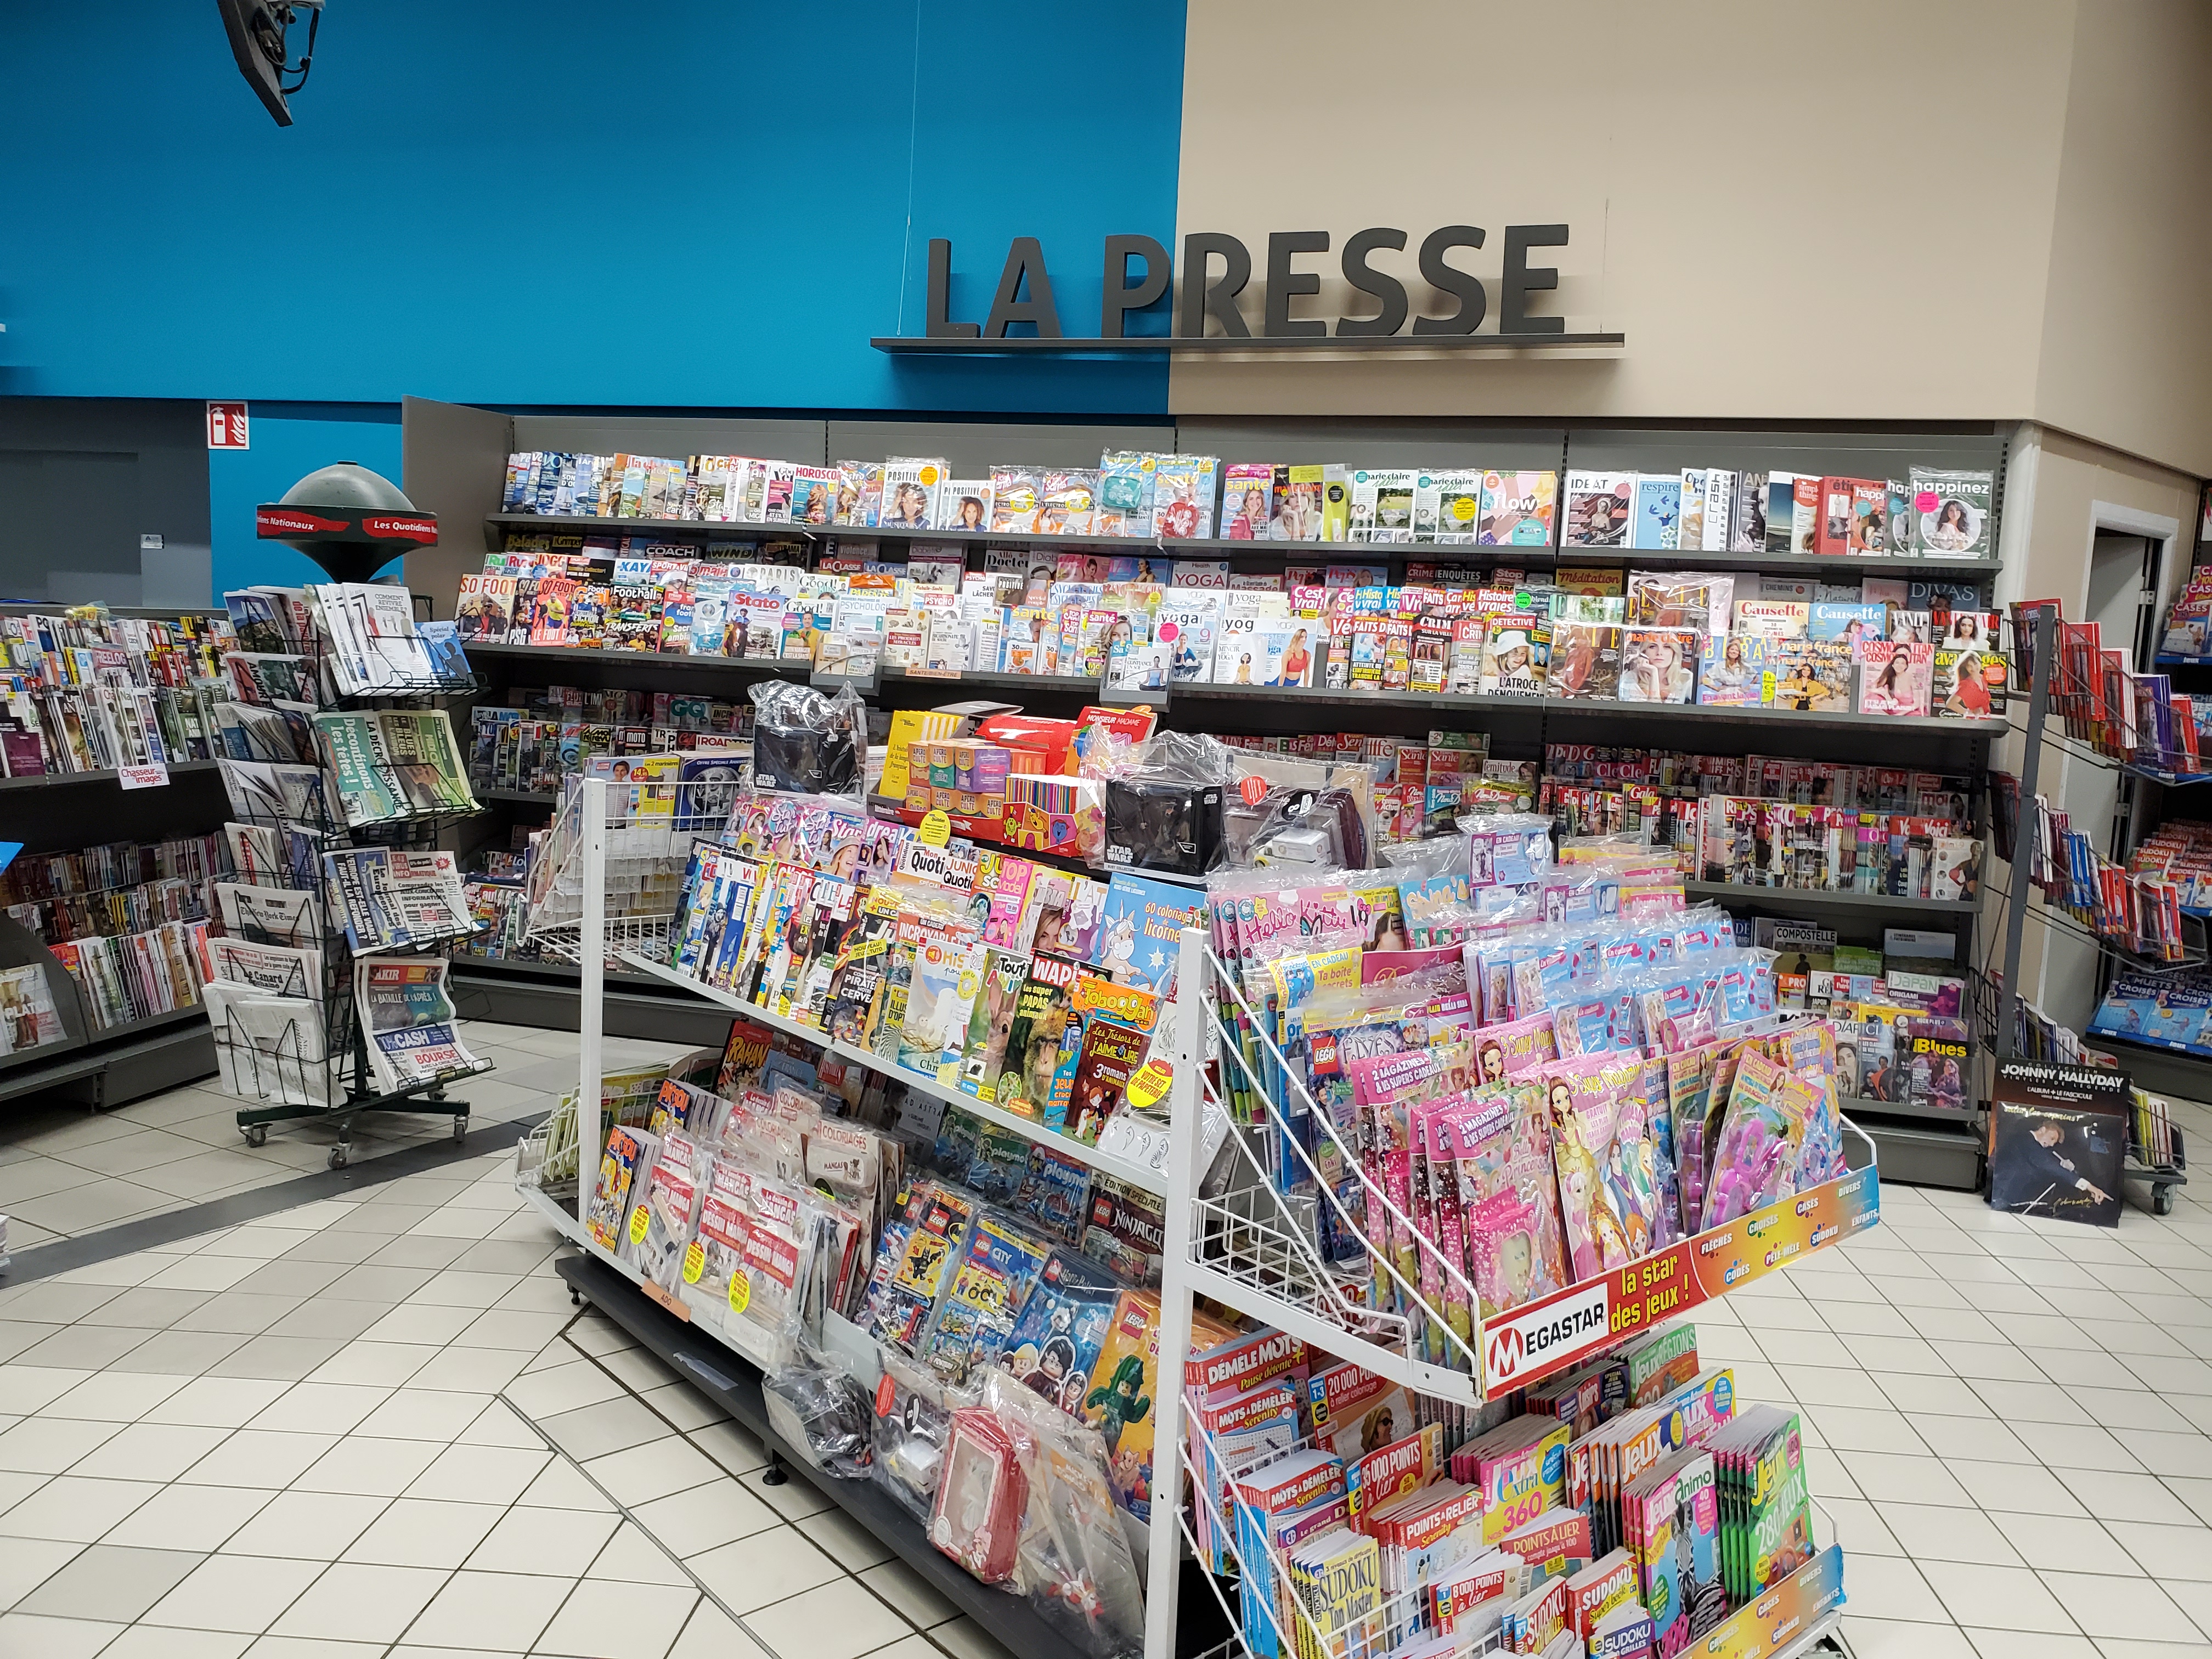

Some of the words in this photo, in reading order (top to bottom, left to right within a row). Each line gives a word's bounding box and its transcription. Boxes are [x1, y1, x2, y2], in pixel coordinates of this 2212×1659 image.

[926, 236, 1062, 340] LA
[1101, 224, 1568, 340] PRESSE
[1227, 479, 1269, 489] santé
[1641, 483, 1678, 493] respire
[1914, 481, 1989, 494] happinez
[1493, 492, 1537, 510] flow
[270, 517, 314, 531] Nationaux
[374, 521, 390, 529] Les
[393, 522, 430, 533] Quotidiens
[646, 547, 695, 556] COACH
[710, 548, 753, 560] WIND
[832, 561, 861, 572] CLASSE
[1408, 569, 1434, 578] CRIME
[1437, 569, 1481, 580] ENQUÊTES
[1496, 568, 1523, 578] Stop
[759, 568, 795, 582] PARIS
[1175, 573, 1225, 587] YOGA
[1559, 572, 1620, 584] Méditation
[460, 578, 478, 593] SO
[482, 579, 517, 595] FOOT
[1294, 586, 1323, 599] C'est
[1911, 583, 1974, 601] DIVAS
[375, 593, 404, 601] COMMENT
[734, 593, 780, 609] Stato
[926, 596, 952, 606] PSYCHO
[1235, 594, 1261, 605] yoga
[1012, 606, 1057, 620] santé
[1478, 601, 1513, 613] vraies
[1741, 601, 1804, 618] Causette
[1817, 605, 1881, 620] Causette
[1089, 614, 1115, 623] santé
[1492, 618, 1534, 627] DETECTIVE
[509, 629, 527, 645] PSG
[543, 629, 563, 641] FOOT
[1814, 642, 1853, 654] france
[670, 700, 705, 718] GQ
[366, 721, 375, 733] LA
[1087, 714, 1116, 724] MONSIEUR
[1117, 717, 1142, 727] MADAME
[330, 726, 345, 744] les
[396, 728, 408, 755] BLEUS
[403, 729, 416, 756] BLUES
[627, 732, 645, 743] MOTO
[337, 747, 354, 777] têtes
[1431, 751, 1459, 763] Santé
[121, 769, 155, 778] Chasseur
[1483, 761, 1515, 774] femitude
[755, 780, 776, 788] WARS
[1925, 820, 1948, 837] Voici
[1111, 845, 1133, 856] STAR
[2140, 848, 2169, 856] SUDOKU
[2152, 839, 2182, 849] SUDOKU
[899, 842, 910, 870] Quotidien
[924, 849, 938, 858] Mon
[1107, 853, 1133, 864] WARS
[2137, 856, 2166, 865] SUDOKU
[911, 851, 946, 874] Quoti
[1001, 860, 1028, 881] TOP
[264, 910, 279, 921] York
[1144, 901, 1155, 914] 60
[348, 899, 364, 934] REFONDER
[1245, 906, 1297, 945] Hello
[1300, 899, 1350, 931] Kitty
[363, 917, 378, 941] VIABLE
[1776, 927, 1836, 943] COMPOSTELLE
[1000, 957, 1026, 979] Tout
[1311, 960, 1322, 969] EN
[1322, 952, 1349, 966] CADEAU
[255, 971, 284, 984] Canard
[1318, 969, 1328, 981] Ta
[1330, 967, 1352, 979] boîte
[1023, 984, 1032, 992] Les
[1032, 985, 1053, 997] super
[2119, 983, 2157, 996] CROISÉS
[2134, 975, 2172, 990] MUETS
[1023, 994, 1049, 1010] PAPAS
[1888, 989, 1918, 1000] ORIGAMI
[2169, 993, 2209, 1006] CROISÉS
[1084, 988, 1154, 1021] Toboggan
[1019, 1009, 1048, 1021] animaux
[394, 1030, 431, 1048] CASH
[1092, 1028, 1105, 1038] Les
[1106, 1029, 1131, 1045] Trésors
[727, 1037, 772, 1068] RAHAN
[1314, 1046, 1336, 1064] LEGO
[1919, 1038, 1967, 1058] Blues
[415, 1049, 457, 1064] BOURSE
[1093, 1063, 1104, 1079] 3
[1103, 1067, 1127, 1081] romans
[1413, 1062, 1442, 1081] CADEAUX
[2001, 1064, 2057, 1080] JOHNNY
[2058, 1070, 2124, 1089] HALLYDAY
[2027, 1086, 2050, 1096] L'ALBUM
[2064, 1090, 2094, 1101] FASCICULE
[1465, 1104, 1504, 1131] MAGAZINES
[823, 1125, 867, 1150] COLORIAGES
[1838, 1180, 1862, 1198] DIVERS
[1096, 1205, 1110, 1217] LEGO
[1852, 1208, 1878, 1227] ENFANTS
[929, 1214, 948, 1228] LEGO
[1811, 1225, 1838, 1244] SUDOKU
[974, 1239, 990, 1251] LEGO
[992, 1247, 1013, 1265] CITY
[1621, 1268, 1637, 1295] la
[1643, 1254, 1678, 1286] star
[661, 1293, 672, 1306] ADO
[1611, 1301, 1642, 1333] des
[1645, 1286, 1679, 1323] jeux
[1125, 1312, 1147, 1329] LEGO
[1209, 1351, 1257, 1385] DÉMÊLE
[1259, 1335, 1302, 1365] MOTS
[1240, 1374, 1262, 1391] Pause
[1263, 1358, 1293, 1379] détente
[1341, 1372, 1358, 1392] 000
[1218, 1408, 1246, 1428] MOTS
[1250, 1391, 1294, 1415] DÉMÊLER
[1361, 1464, 1372, 1488] 35
[1372, 1457, 1390, 1482] 000
[1390, 1440, 1421, 1475] POINTS
[1271, 1489, 1298, 1508] MOTS
[1302, 1466, 1341, 1492] DÉMÊLER
[1699, 1489, 1709, 1499] 40
[1407, 1516, 1440, 1541] POINTS
[1446, 1496, 1479, 1522] RELIER
[1503, 1490, 1543, 1531] 360
[1755, 1515, 1782, 1555] 280
[1781, 1469, 1805, 1525] JEUX
[1300, 1528, 1308, 1538] Le
[1308, 1515, 1331, 1536] grand
[1513, 1530, 1550, 1554] POINTS
[1559, 1521, 1581, 1541] LIER
[1319, 1552, 1378, 1610] SUDOKU
[1475, 1572, 1503, 1593] POINTS
[1799, 1565, 1823, 1587] DIVERS
[1583, 1566, 1632, 1607] SUDOKU
[1813, 1588, 1840, 1612] ENFANTS
[1604, 1621, 1651, 1650] SUDOKU
[1773, 1615, 1800, 1644] SUDOKU
